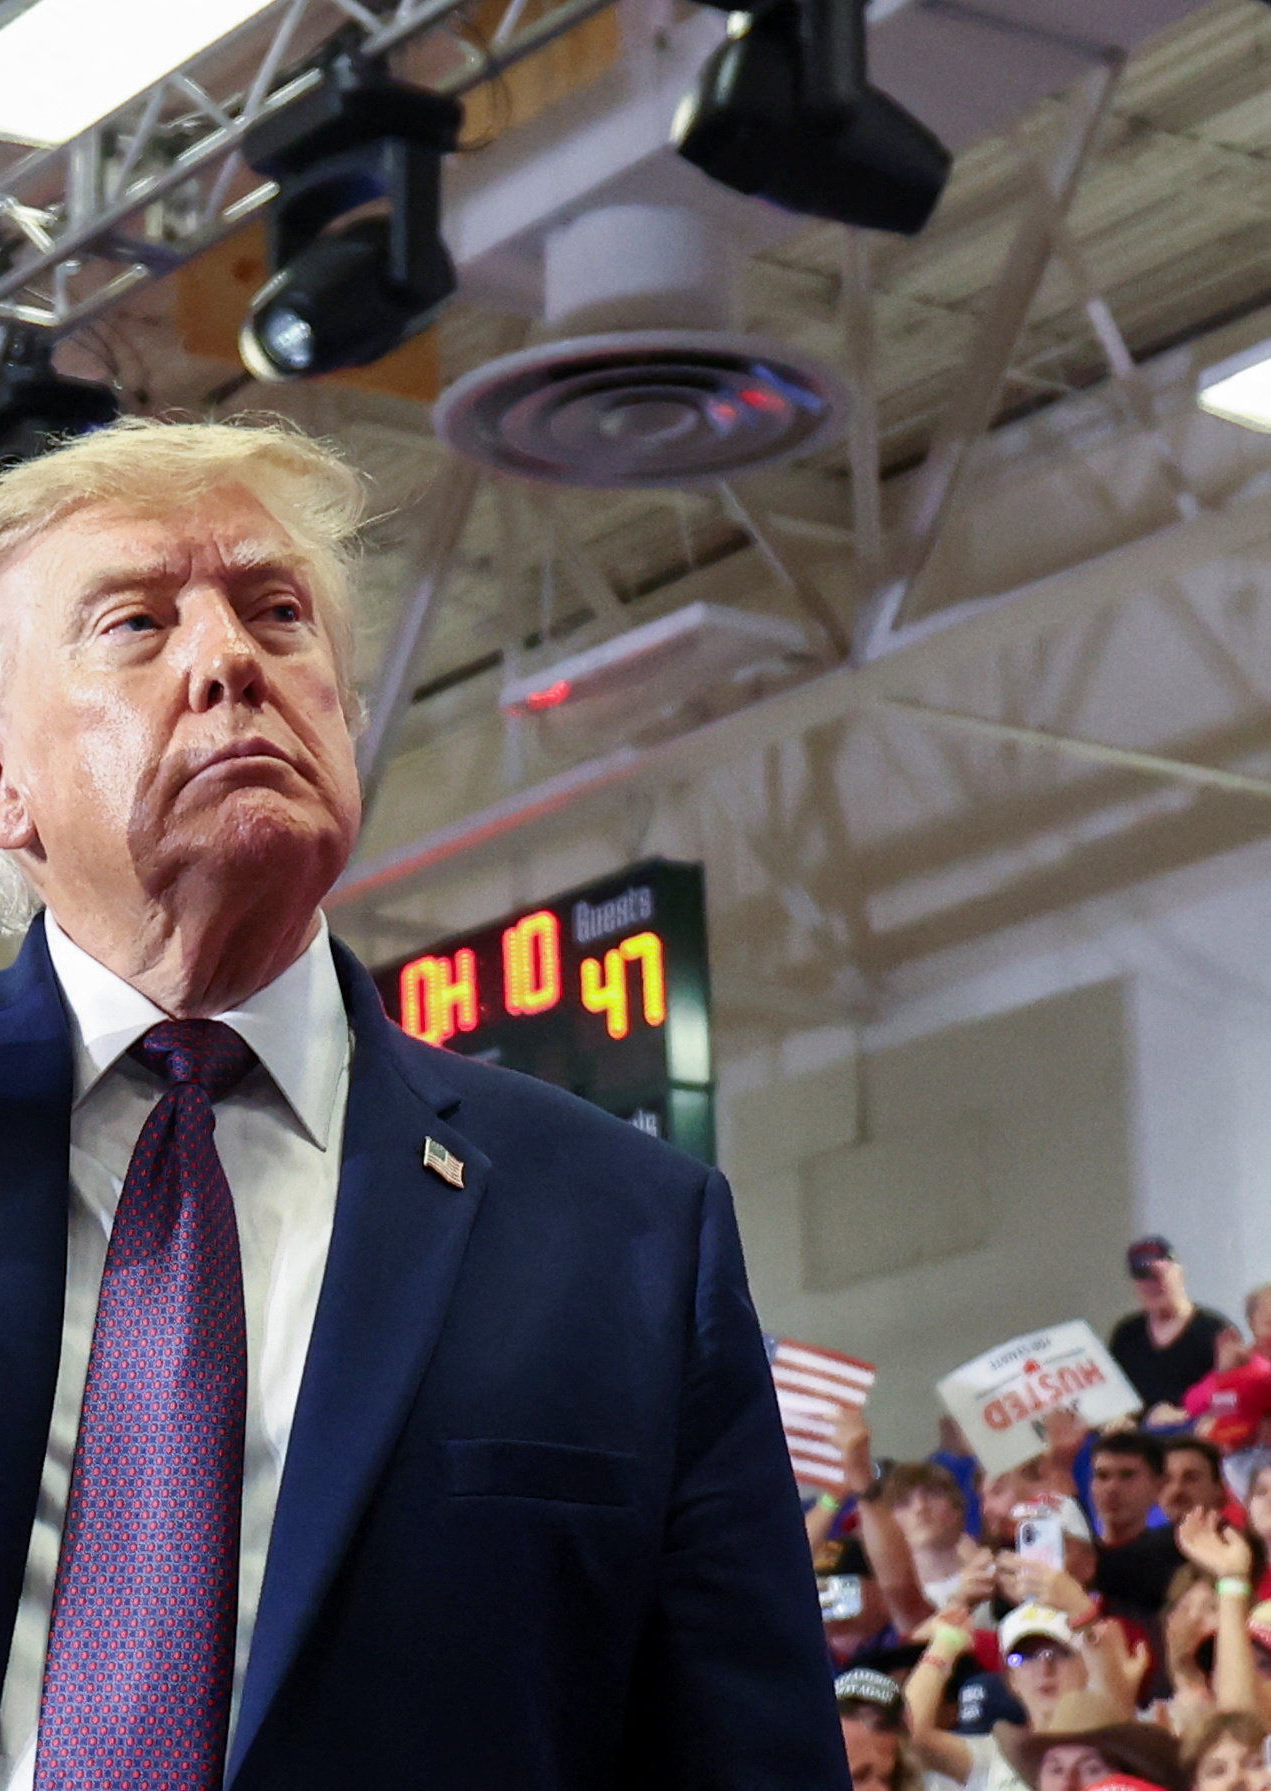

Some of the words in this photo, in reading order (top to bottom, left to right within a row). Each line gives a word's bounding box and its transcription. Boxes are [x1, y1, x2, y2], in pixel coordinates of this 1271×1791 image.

[575, 886, 651, 943] Guests
[581, 931, 666, 1039] 47
[984, 1358, 1107, 1431] HUSTED
